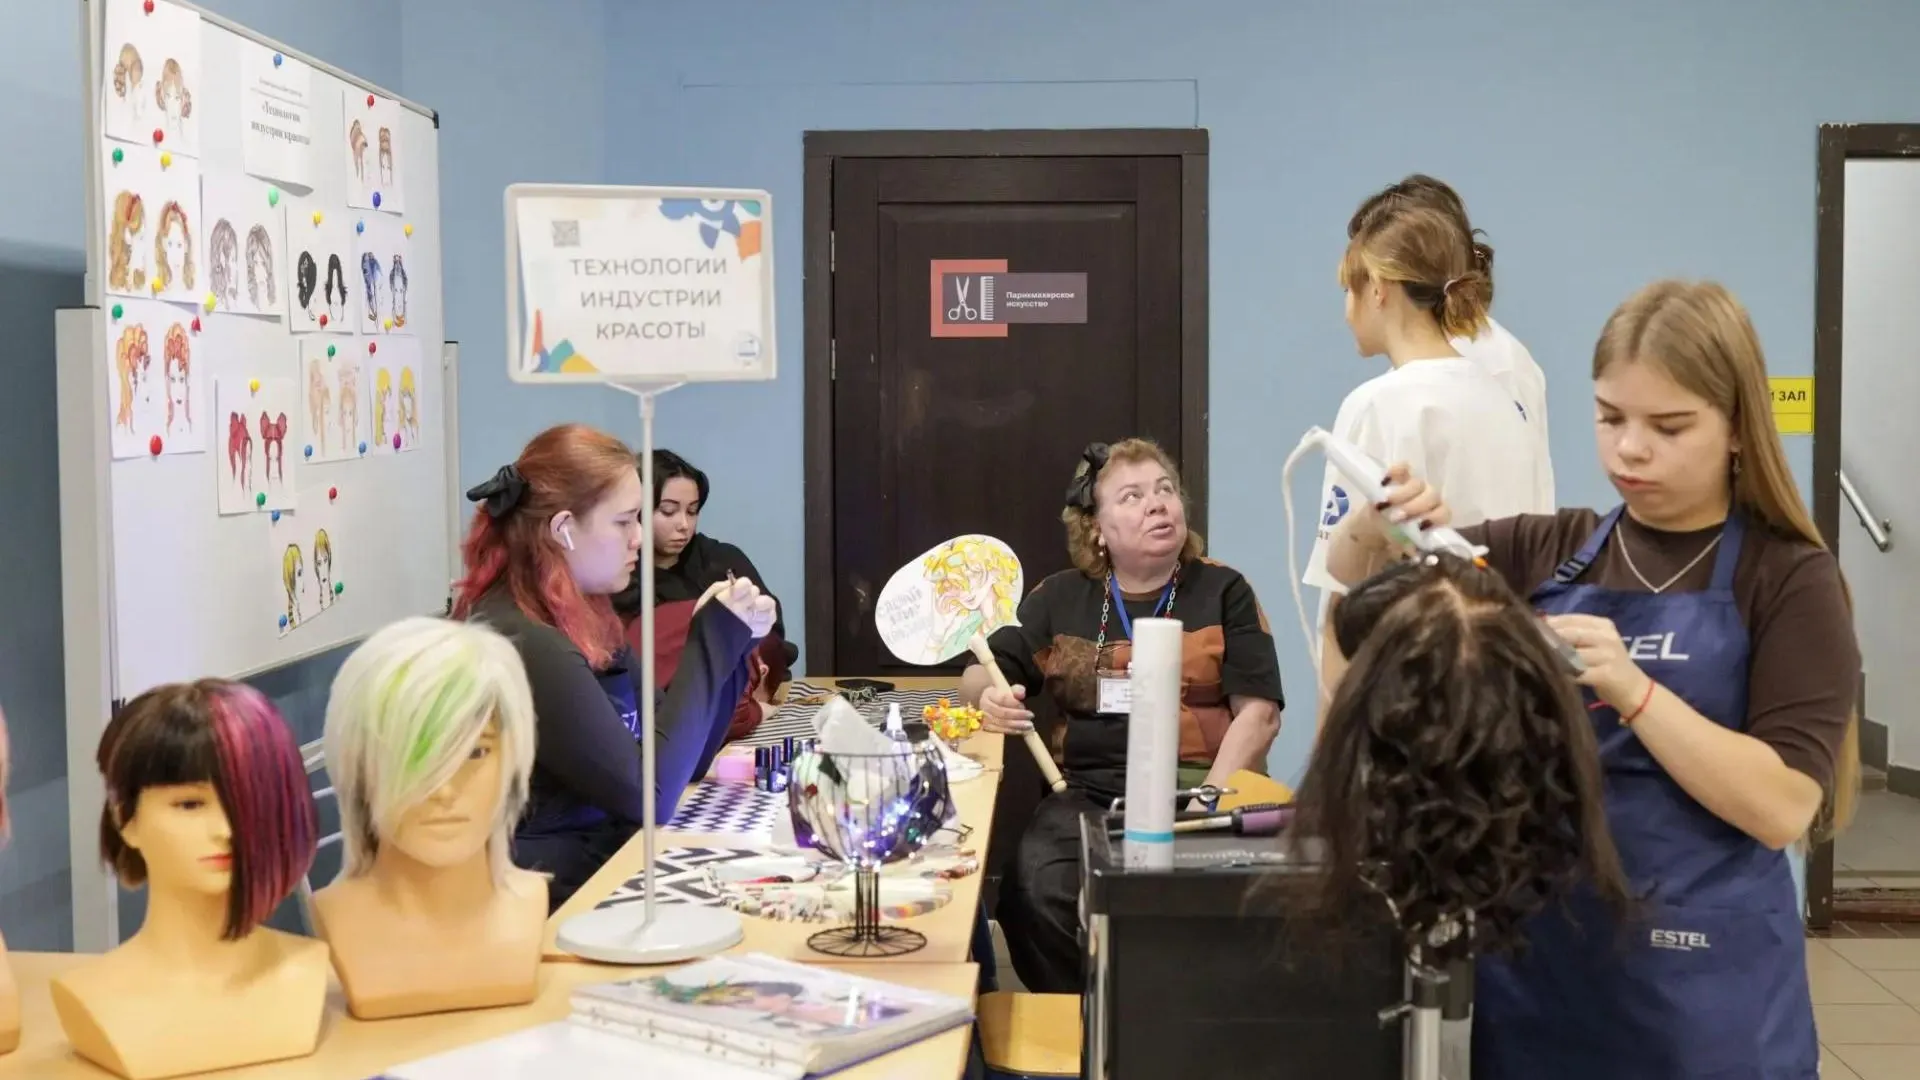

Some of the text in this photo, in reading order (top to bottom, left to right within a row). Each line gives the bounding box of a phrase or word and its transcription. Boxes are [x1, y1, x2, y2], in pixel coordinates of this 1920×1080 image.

[569, 257, 728, 277] ТЕХНОЛОГИИ
[580, 289, 722, 310] ИНДУСТРИИ
[1005, 291, 1075, 300] Парикмахерское
[1005, 300, 1049, 309] искусство
[596, 321, 706, 340] КРАСОТЫ
[1778, 390, 1806, 402] ЗАЛ
[1650, 928, 1711, 949] ESTEL
